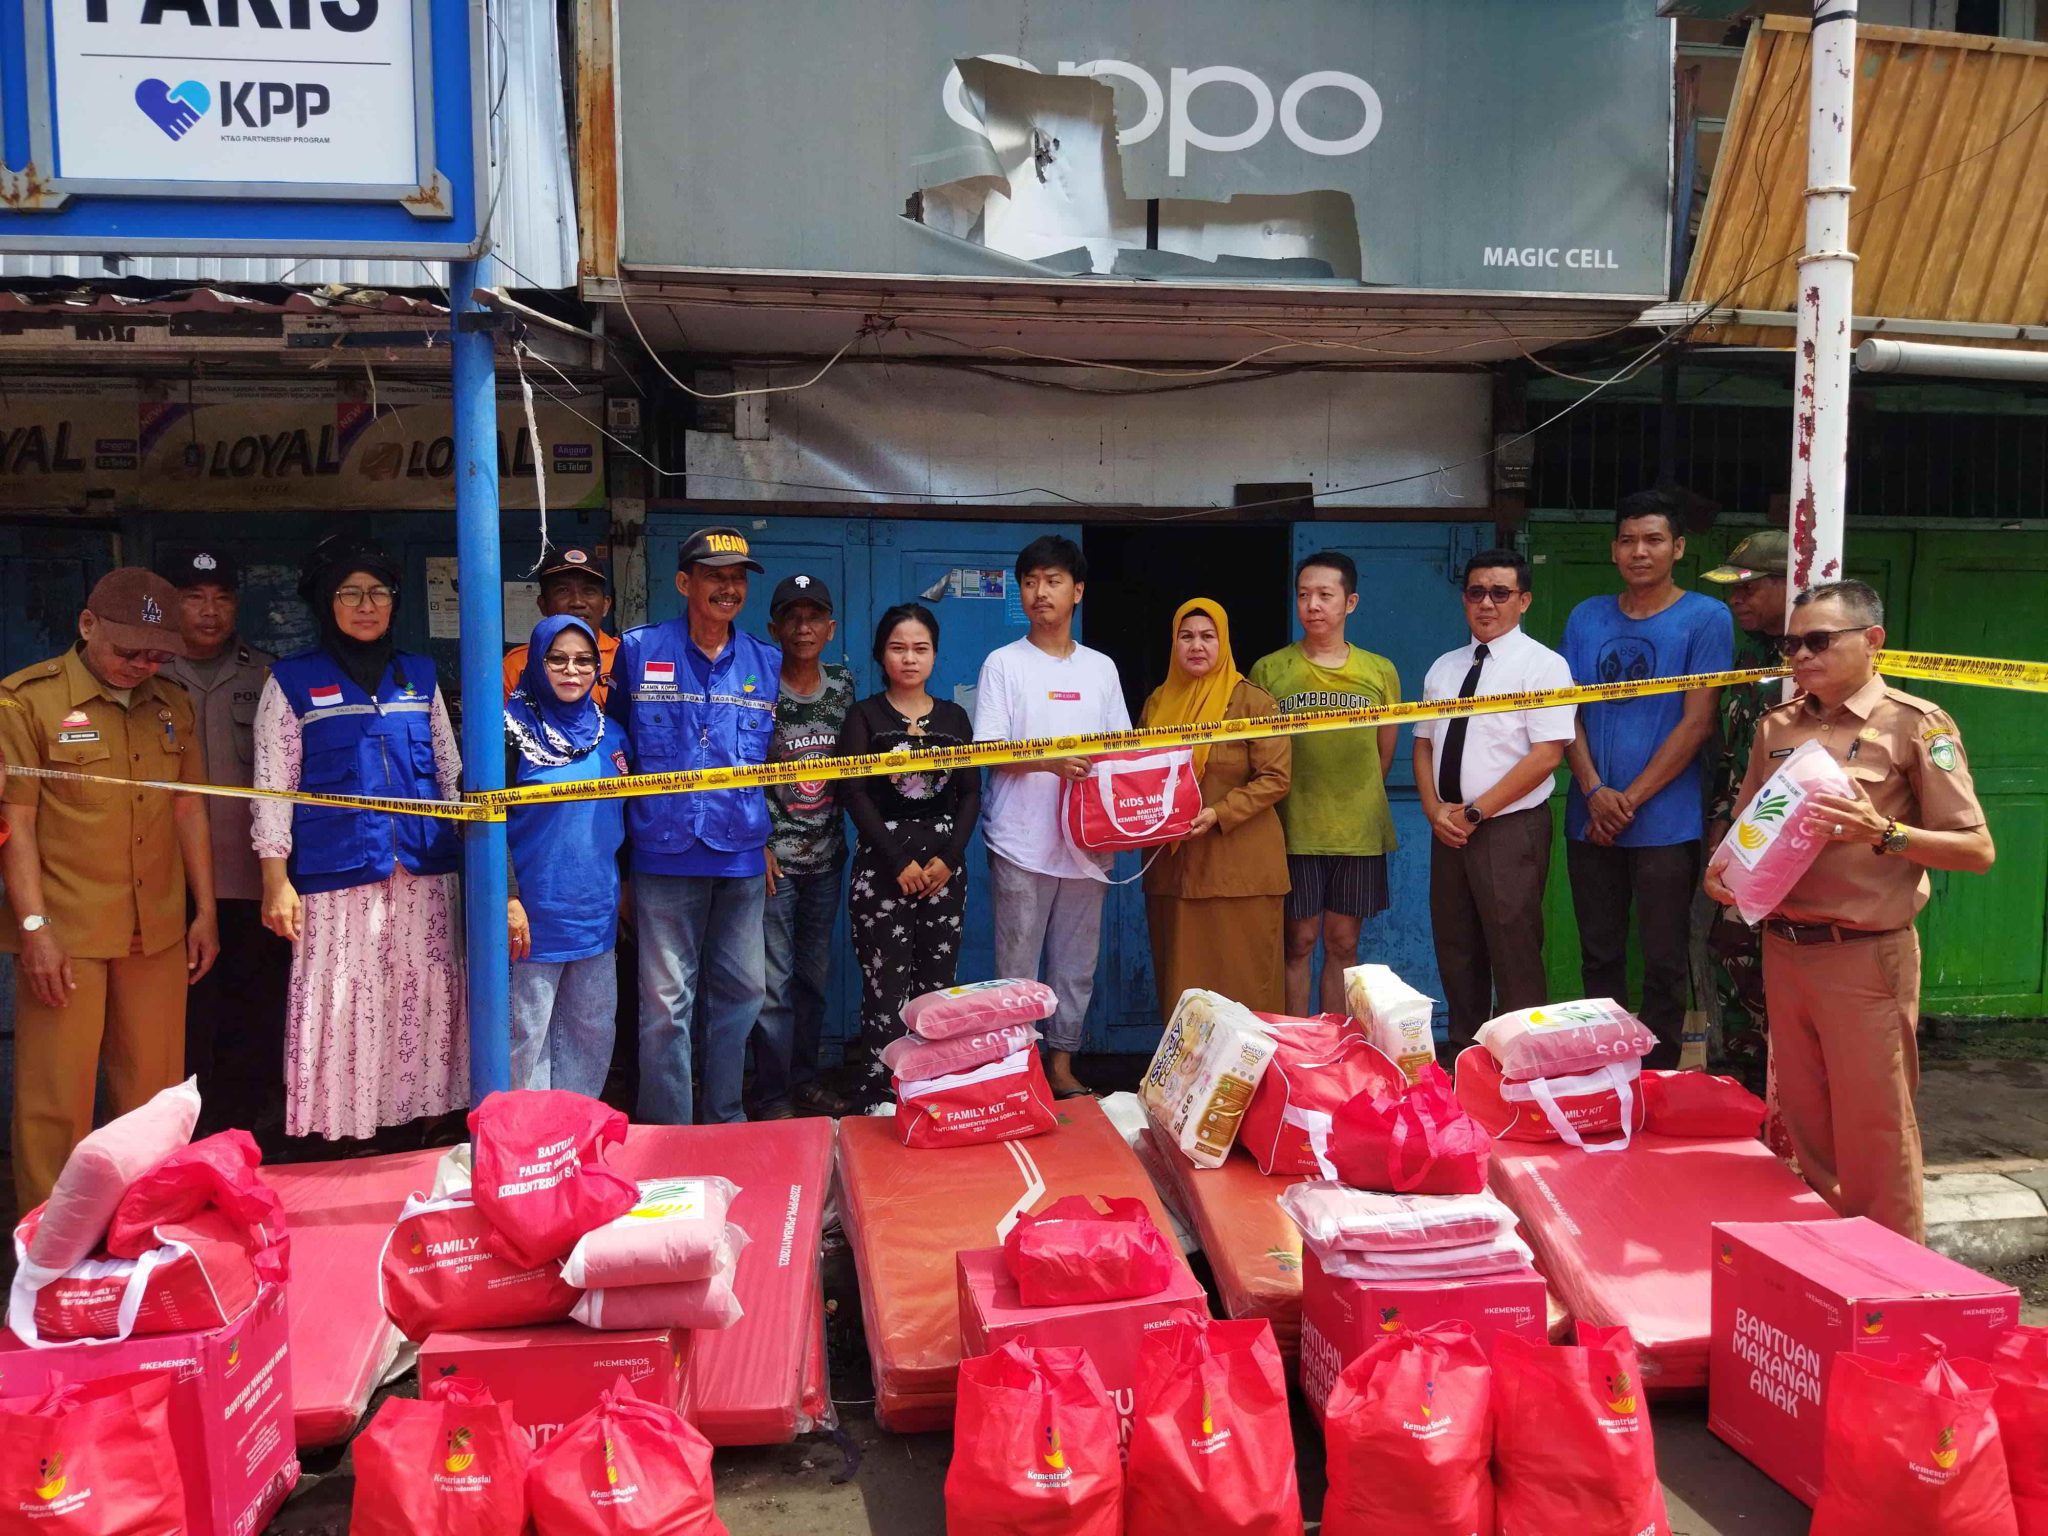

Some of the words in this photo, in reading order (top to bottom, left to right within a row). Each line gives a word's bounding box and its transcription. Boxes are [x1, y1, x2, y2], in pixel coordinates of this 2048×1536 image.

[219, 80, 331, 129] KPP
[242, 135, 293, 143] PARTNERSHIP
[1483, 246, 1560, 269] MAGIC
[1565, 248, 1620, 270] CELL
[339, 404, 363, 430] NEW
[0, 420, 86, 475] YAL
[209, 423, 342, 478] LOYAL
[406, 424, 545, 479] LOL
[557, 445, 590, 458] Anggur
[557, 462, 569, 472] Es
[570, 462, 589, 472] Teler
[2001, 663, 2026, 678] POLISI
[233, 691, 260, 701] POL
[785, 734, 836, 751] TAGANA
[1181, 734, 1200, 742] POLICE
[1201, 732, 1213, 741] LINE
[910, 745, 952, 760] DILARANG
[1026, 737, 1053, 749] POLISI
[1104, 742, 1112, 750] DO
[1112, 741, 1122, 750] NOT
[1123, 740, 1141, 749] CROSS
[933, 758, 942, 768] DO
[942, 757, 953, 767] NOT
[954, 756, 972, 766] CROSS
[1012, 751, 1032, 760] POLICE
[1032, 749, 1045, 758] LINE
[732, 763, 776, 778] DILARANG
[779, 758, 824, 772] MELINTAS
[824, 755, 851, 768] GARIS
[853, 753, 881, 765] POLISI
[840, 768, 859, 776] POLICE
[860, 766, 873, 775] LINE
[551, 781, 596, 797] DILARANG
[598, 775, 644, 792] MELINTAS
[644, 773, 671, 787] GARIS
[674, 769, 704, 782] POLISI
[758, 776, 766, 784] DO
[766, 775, 777, 783] NOT
[778, 773, 797, 782] CROSS
[1119, 797, 1144, 809] KIDS
[1146, 794, 1164, 805] WA
[946, 1106, 986, 1122] FAMILY
[988, 1102, 1006, 1115] KIT
[1564, 1108, 1588, 1120] MILY
[1588, 1105, 1604, 1116] KIT
[537, 1134, 575, 1159] BANTUA
[518, 1161, 552, 1178] PAKET
[426, 1236, 480, 1258] FAMILY
[436, 1252, 493, 1268] KEMENTERIAN
[455, 1263, 473, 1274] 2024
[1483, 1305, 1531, 1316] #KEMENSOS
[1962, 1306, 2006, 1317] #KEMENSOS
[1143, 1318, 1178, 1331] #KEMEN
[1735, 1307, 1821, 1379] BANTUAN
[139, 1358, 198, 1371] #KEMENSOS
[593, 1357, 650, 1369] #KEMENSOS
[1301, 1338, 1339, 1389] AKANA
[1732, 1335, 1821, 1407] MAKANAN
[1750, 1368, 1799, 1420] ANAK
[467, 1475, 492, 1484] Sosial
[1027, 1470, 1063, 1482] Kementri
